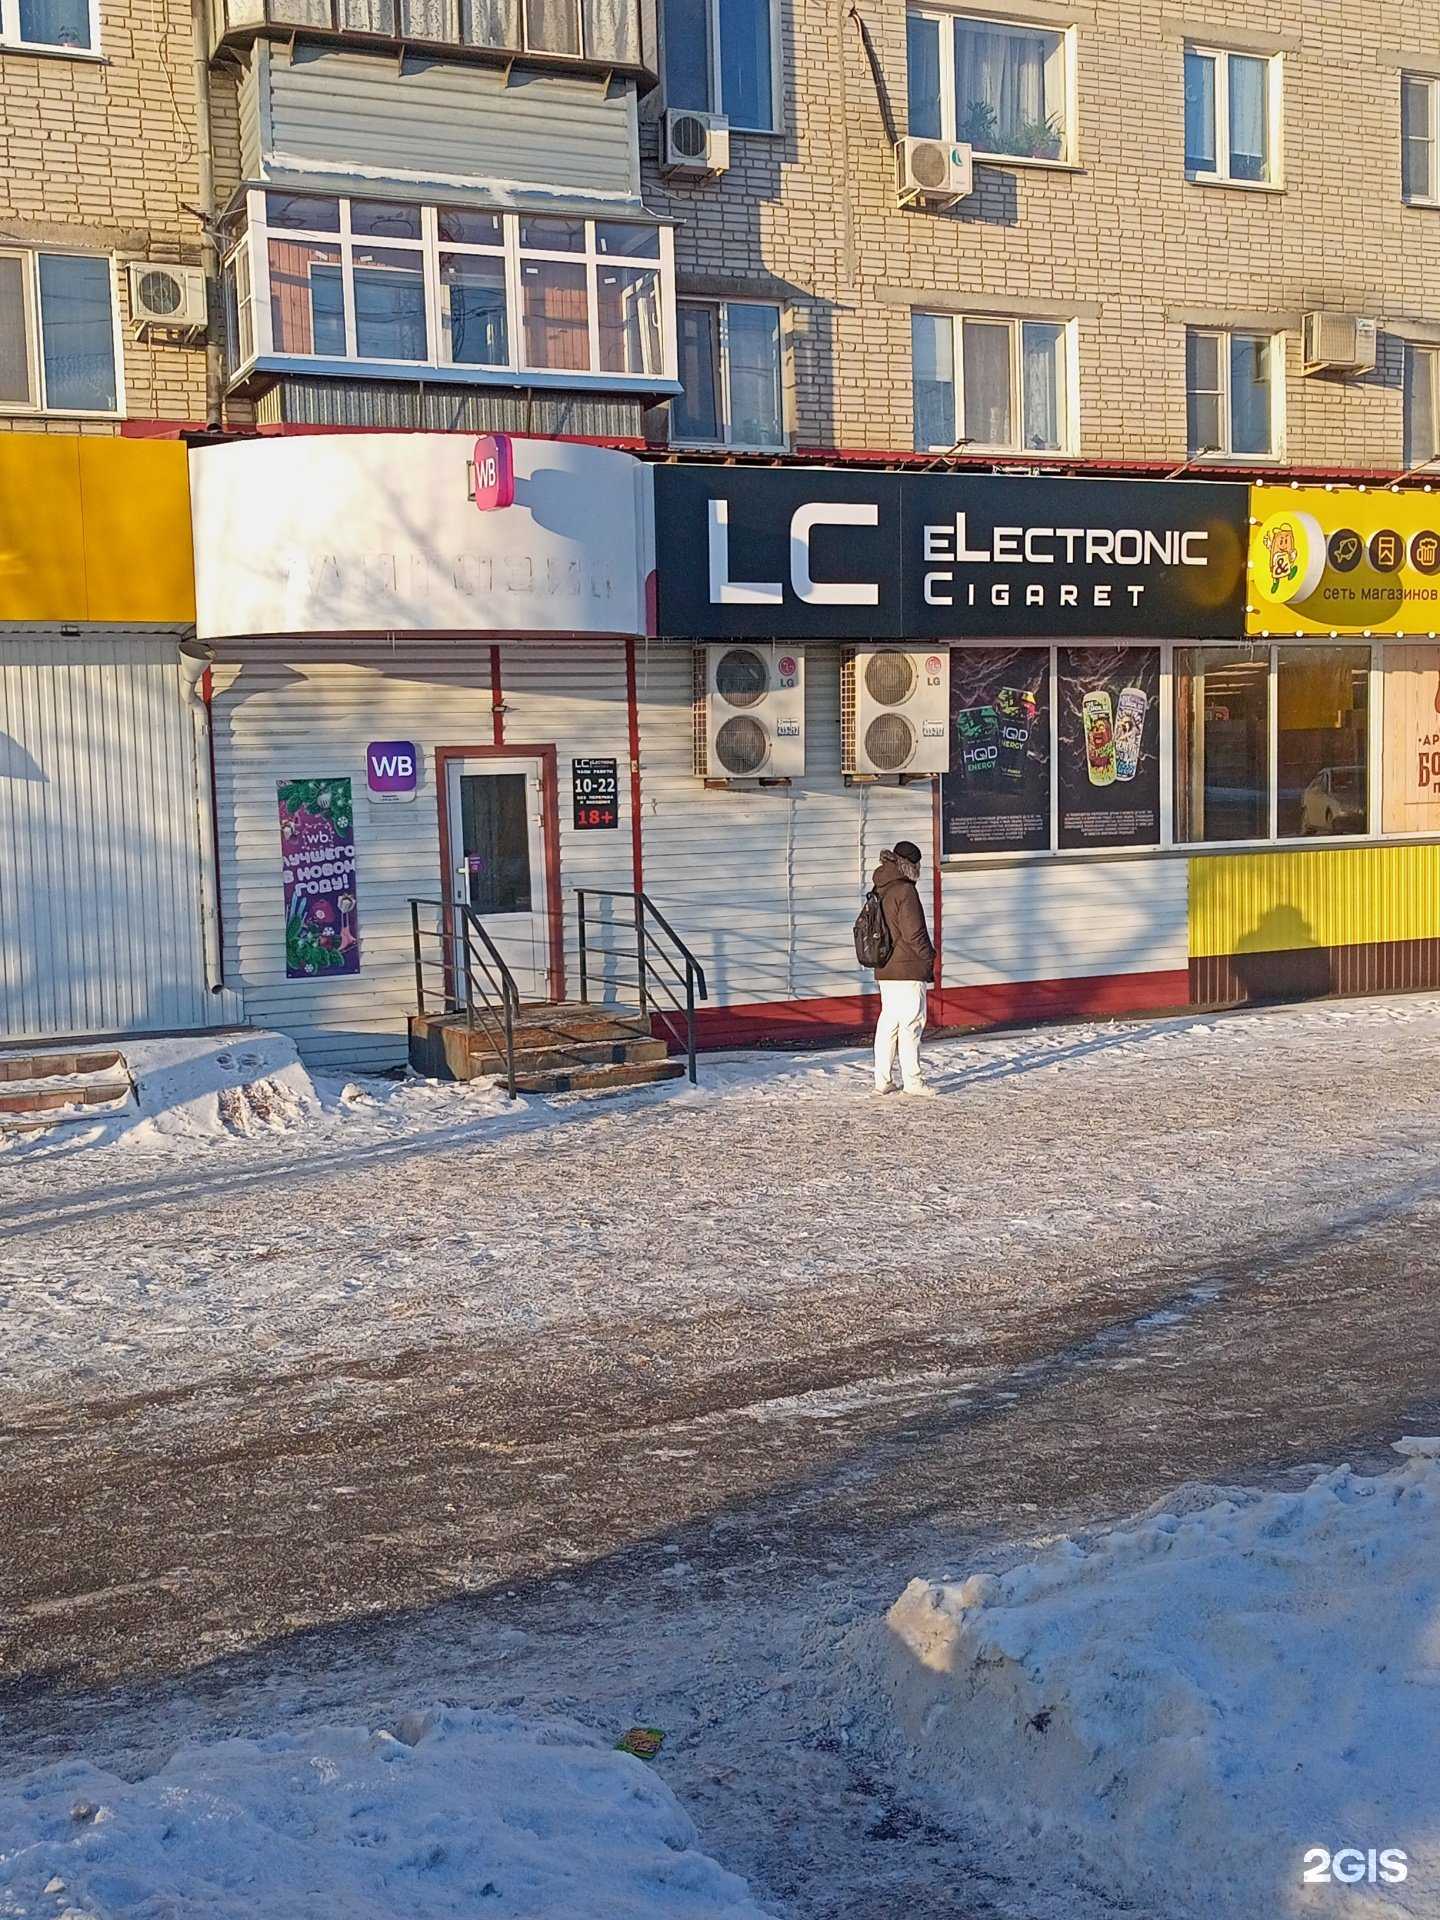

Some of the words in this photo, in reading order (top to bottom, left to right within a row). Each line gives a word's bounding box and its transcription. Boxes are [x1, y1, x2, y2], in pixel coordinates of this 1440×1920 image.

[475, 457, 496, 489] WB
[708, 499, 879, 605] LC
[923, 571, 1145, 607] CIGARET
[1323, 587, 1356, 601] сеть
[1361, 587, 1438, 601] магазинов
[780, 678, 794, 688] LG
[927, 676, 941, 687] LG
[963, 745, 998, 763] HQD
[371, 755, 413, 778] WB
[967, 760, 996, 772] ENERGY
[575, 778, 615, 793] 10-22
[578, 809, 613, 825] 18+
[307, 831, 329, 843] wb
[295, 873, 349, 897] ГОДУ!
